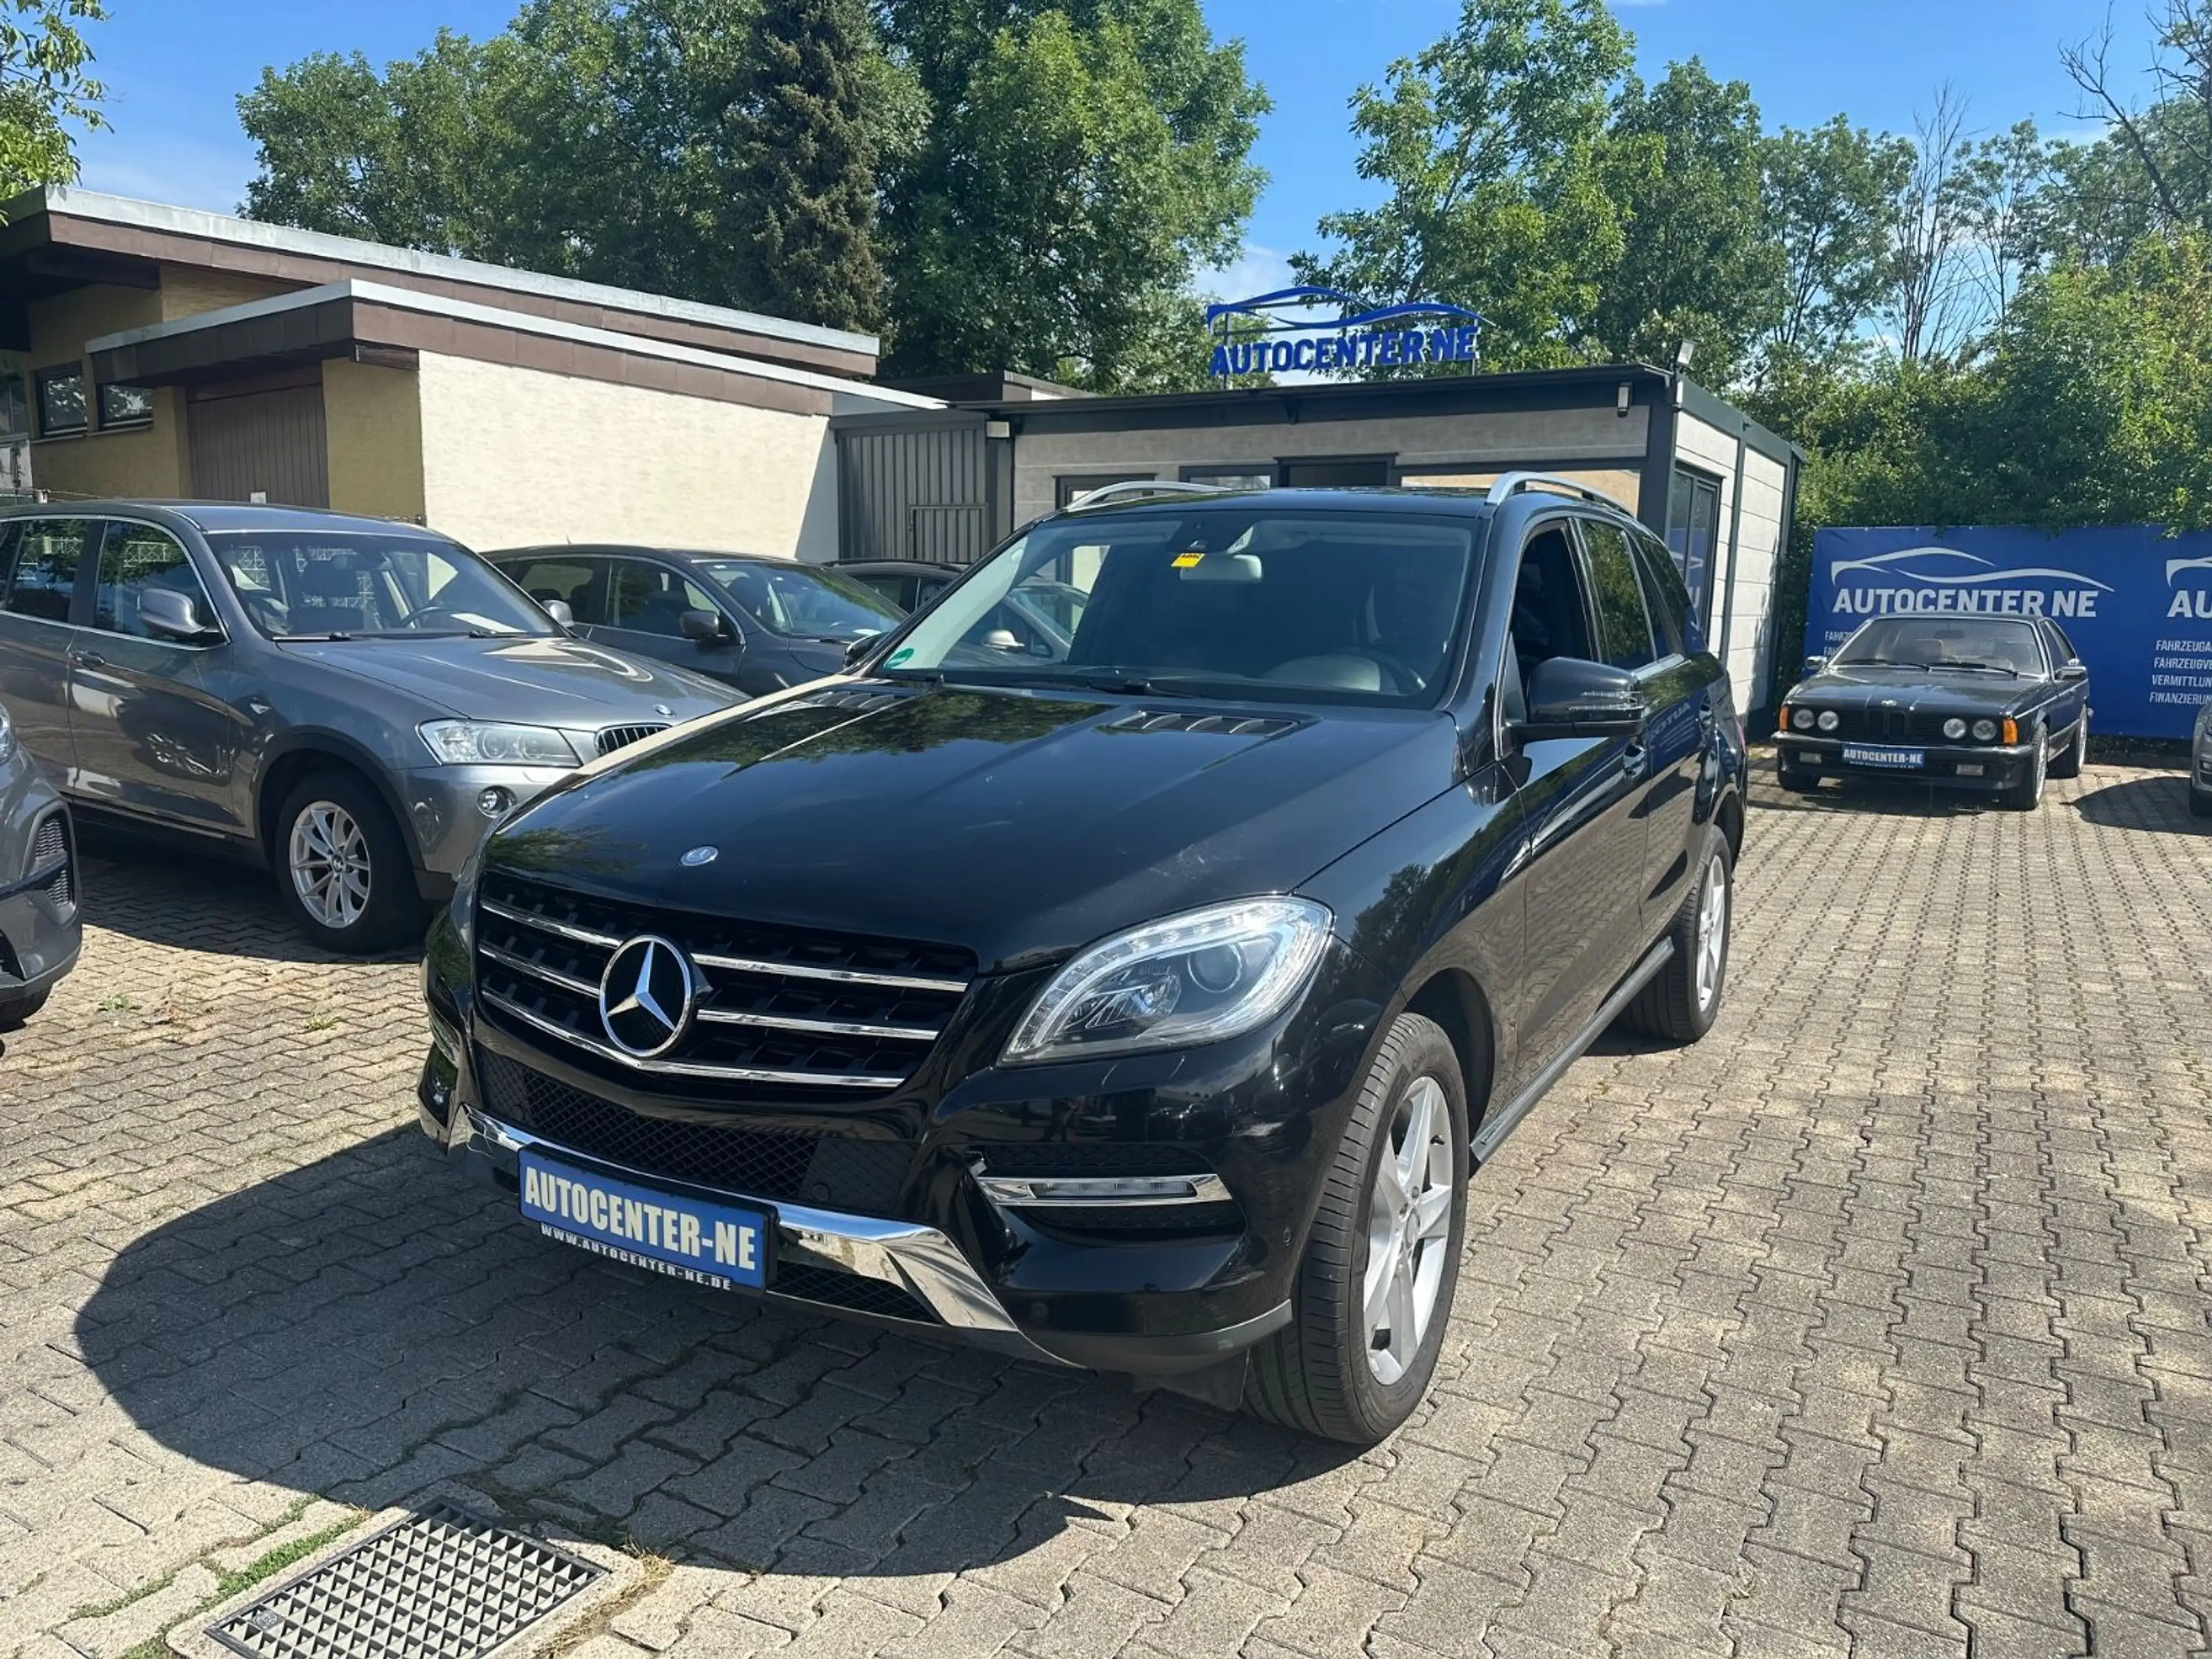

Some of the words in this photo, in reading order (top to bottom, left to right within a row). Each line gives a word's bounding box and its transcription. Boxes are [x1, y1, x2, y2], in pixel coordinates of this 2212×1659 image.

[1210, 331, 1426, 377] AUTOCENTER
[1432, 325, 1481, 362] NE
[1832, 588, 2044, 616] AUTOCENTER
[2051, 590, 2099, 618] NE
[1843, 749, 1923, 764] AUTOCENTER-NE
[525, 1166, 756, 1271] AUTOCENTER-NE
[540, 1223, 732, 1291] WWW.AUTOCENTER-NE.DE
